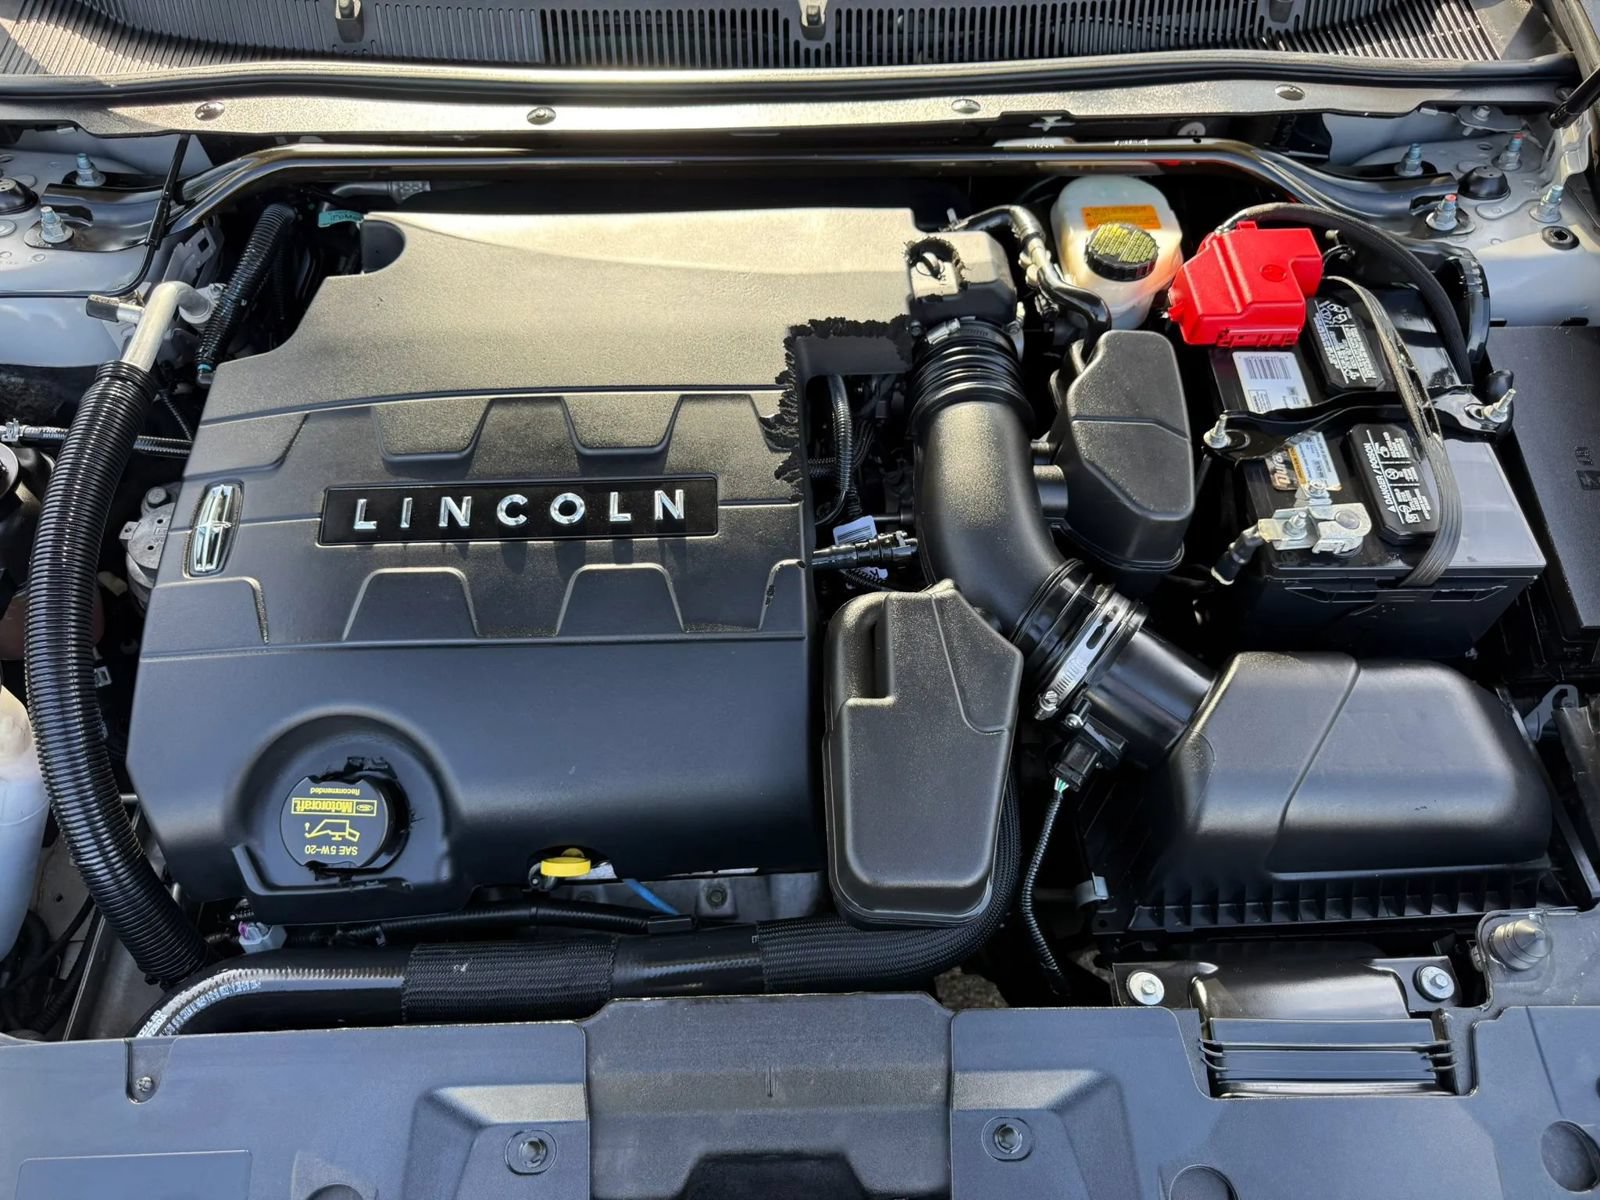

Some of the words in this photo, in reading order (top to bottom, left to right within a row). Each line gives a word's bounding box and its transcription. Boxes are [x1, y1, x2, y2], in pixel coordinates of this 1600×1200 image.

[1363, 443, 1380, 469] POISON
[1375, 475, 1394, 505] DANGER
[353, 488, 685, 531] LINCOLN
[310, 787, 360, 796] Recommended
[294, 799, 353, 813] Motorcraft
[304, 844, 337, 855] 5W-20
[339, 845, 358, 856] SAE
